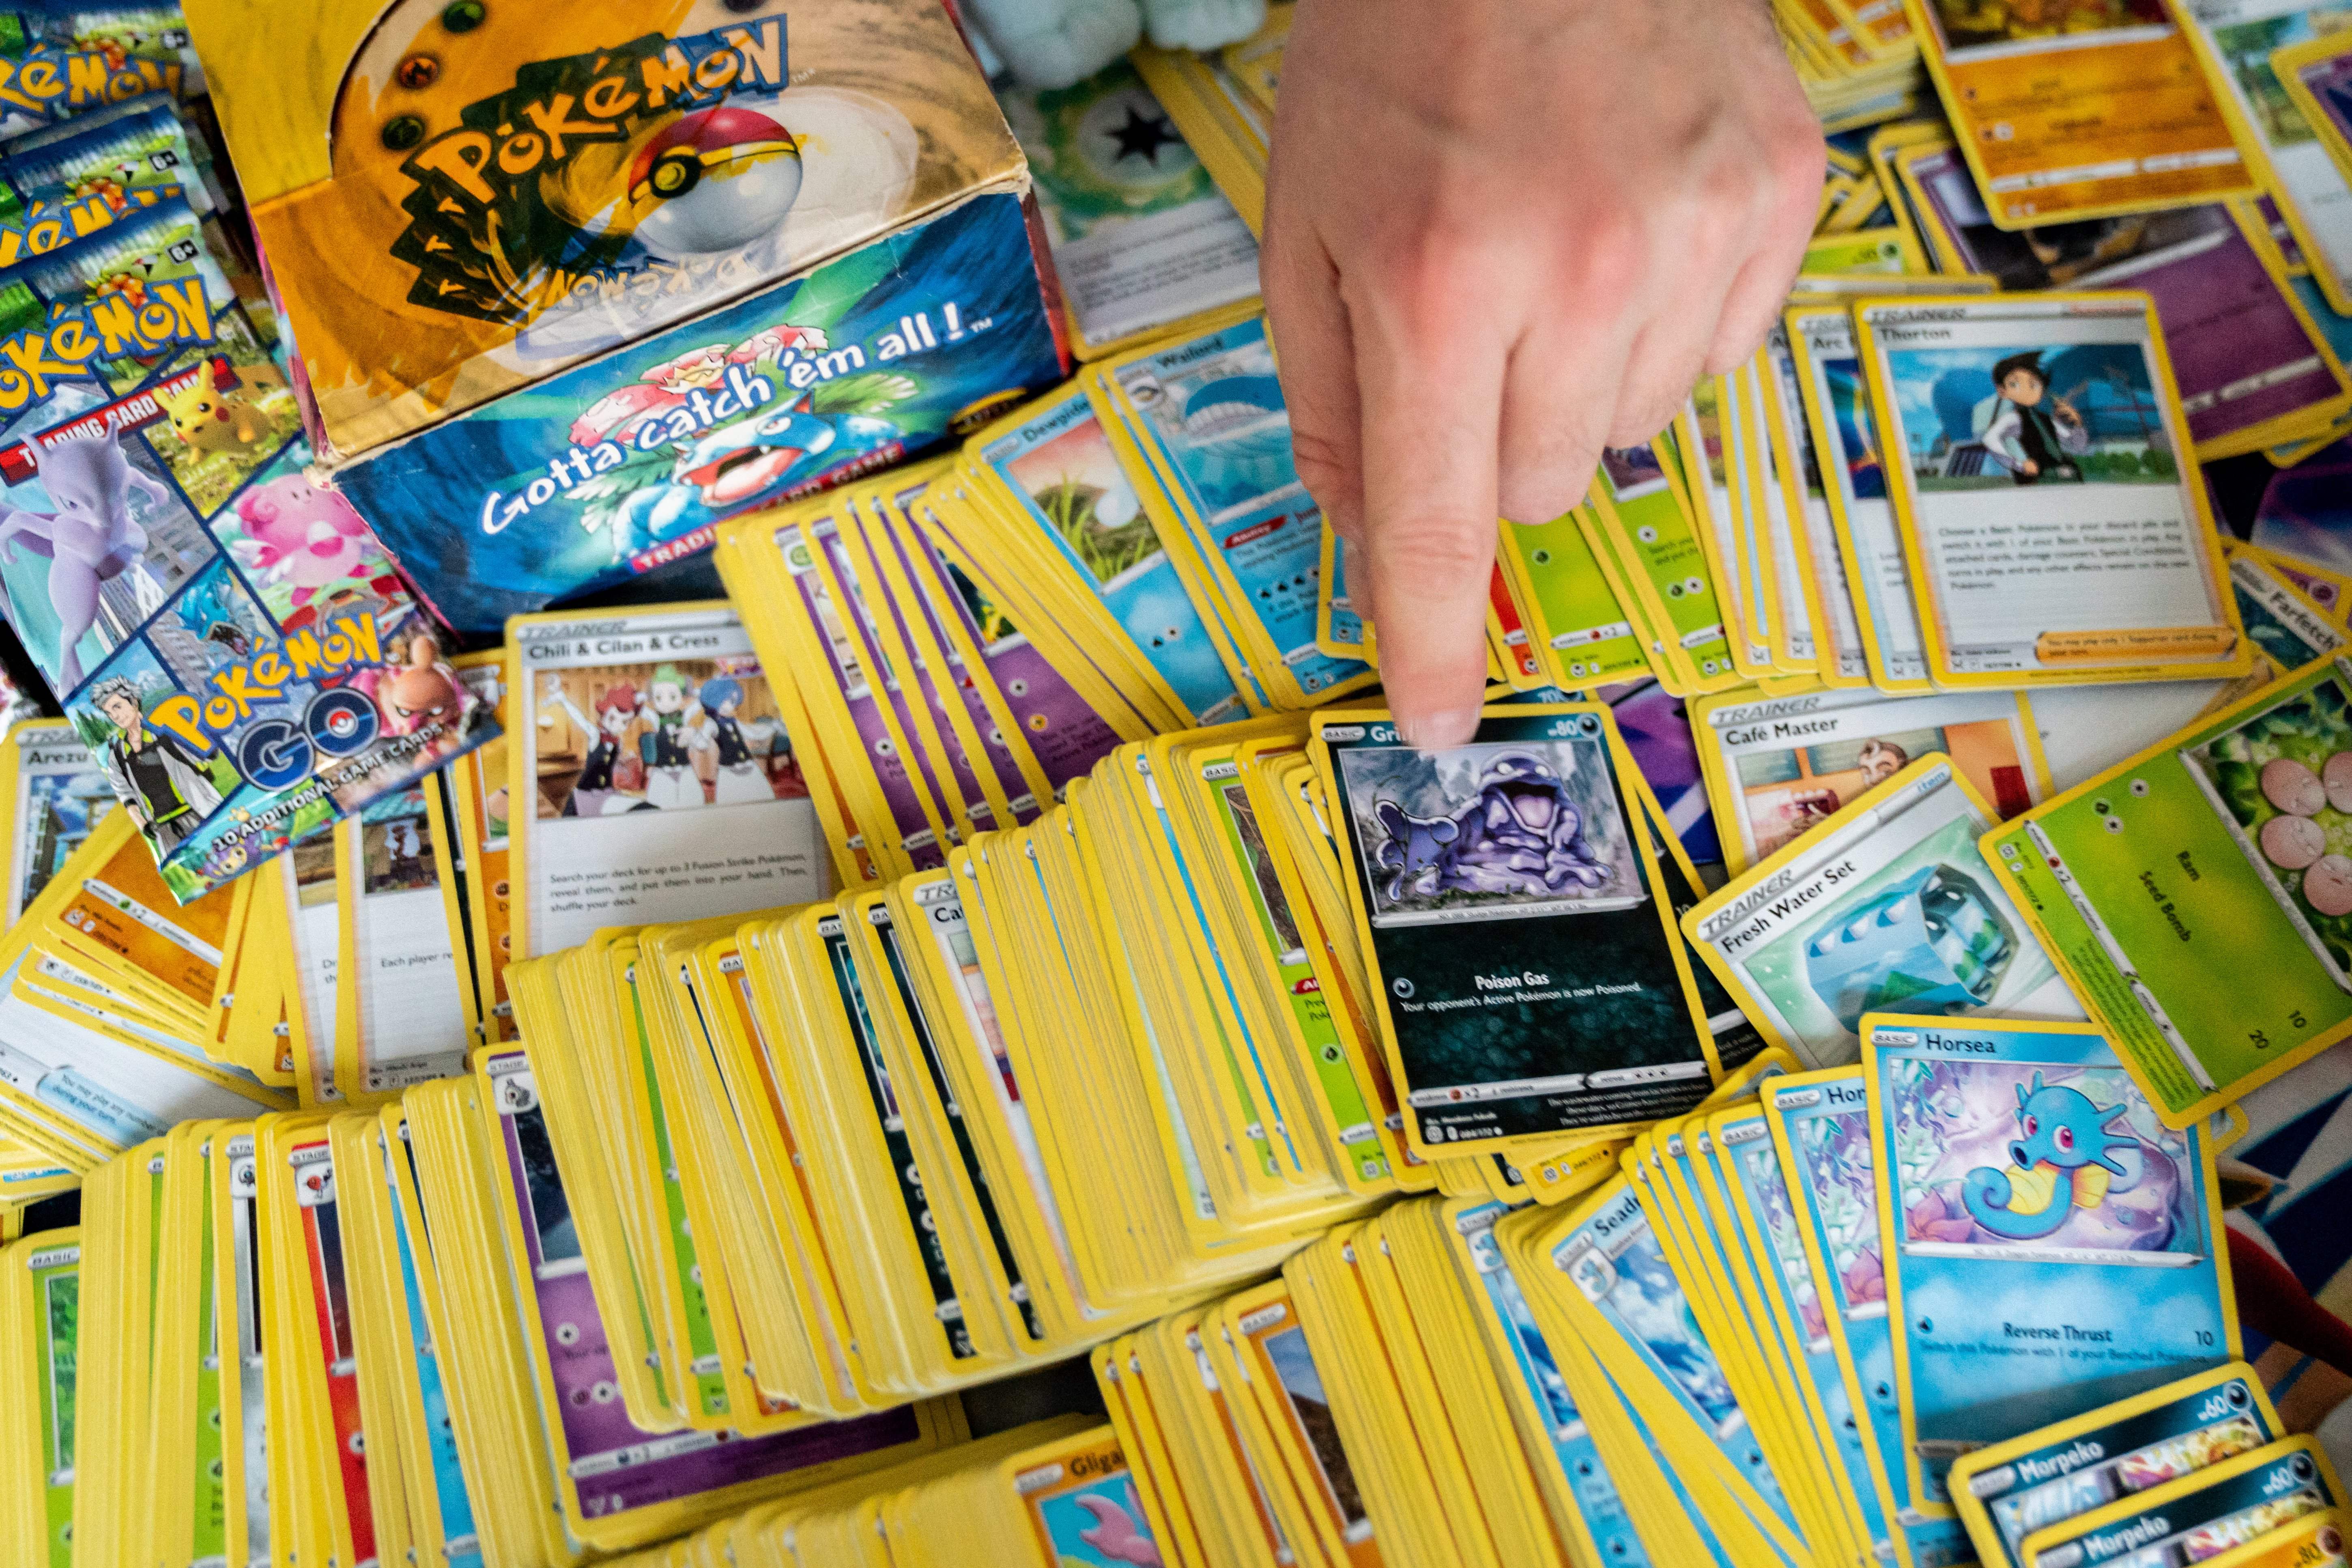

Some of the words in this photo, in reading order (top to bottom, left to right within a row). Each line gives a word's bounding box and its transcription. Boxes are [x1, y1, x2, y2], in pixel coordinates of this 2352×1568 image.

[1879, 327, 1951, 340] Thorton
[483, 440, 623, 535] Gotta
[639, 366, 772, 450] catch
[529, 642, 570, 660] Chili
[577, 642, 590, 656] &
[596, 639, 644, 655] Cilan
[650, 636, 663, 650] &
[669, 633, 720, 649] Cress
[1715, 697, 1821, 724] TRAINER
[238, 687, 381, 792] GO
[1370, 725, 1404, 743] Gri
[1725, 723, 1769, 746] Café
[1773, 717, 1839, 738] Master
[212, 831, 239, 852] 10
[241, 780, 339, 837] ADDITIONAL
[338, 753, 389, 785] GAME
[388, 722, 443, 759] CARDS
[550, 871, 584, 884] Search
[2176, 850, 2201, 882] Ram
[1702, 869, 1797, 936] TRAINER
[1721, 917, 1772, 955] Fresh
[1769, 884, 1823, 922] Water
[1826, 859, 1858, 886] Set
[2138, 871, 2168, 903] Seed
[2161, 902, 2192, 942] Bomb
[381, 953, 405, 968] Each
[408, 951, 439, 967] player
[1474, 974, 1522, 990] Poison
[1523, 971, 1551, 985] Gas
[1400, 1001, 1425, 1013] Your
[1427, 996, 1482, 1012] opponent's
[1483, 994, 1516, 1006] Active
[1514, 989, 1562, 1002] Pokémon
[1563, 989, 1572, 999] is
[1573, 988, 1595, 998] now
[2288, 1010, 2308, 1028] 10
[1925, 1033, 1997, 1054] Horsea
[2249, 1029, 2269, 1050] 20
[2002, 1322, 2060, 1340] Reverse
[2061, 1325, 2112, 1343] Thrust
[2194, 1330, 2214, 1346] 10
[2018, 1440, 2107, 1485] Morpeko
[2204, 1395, 2228, 1418] 60
[2083, 1514, 2171, 1559] Morpeko
